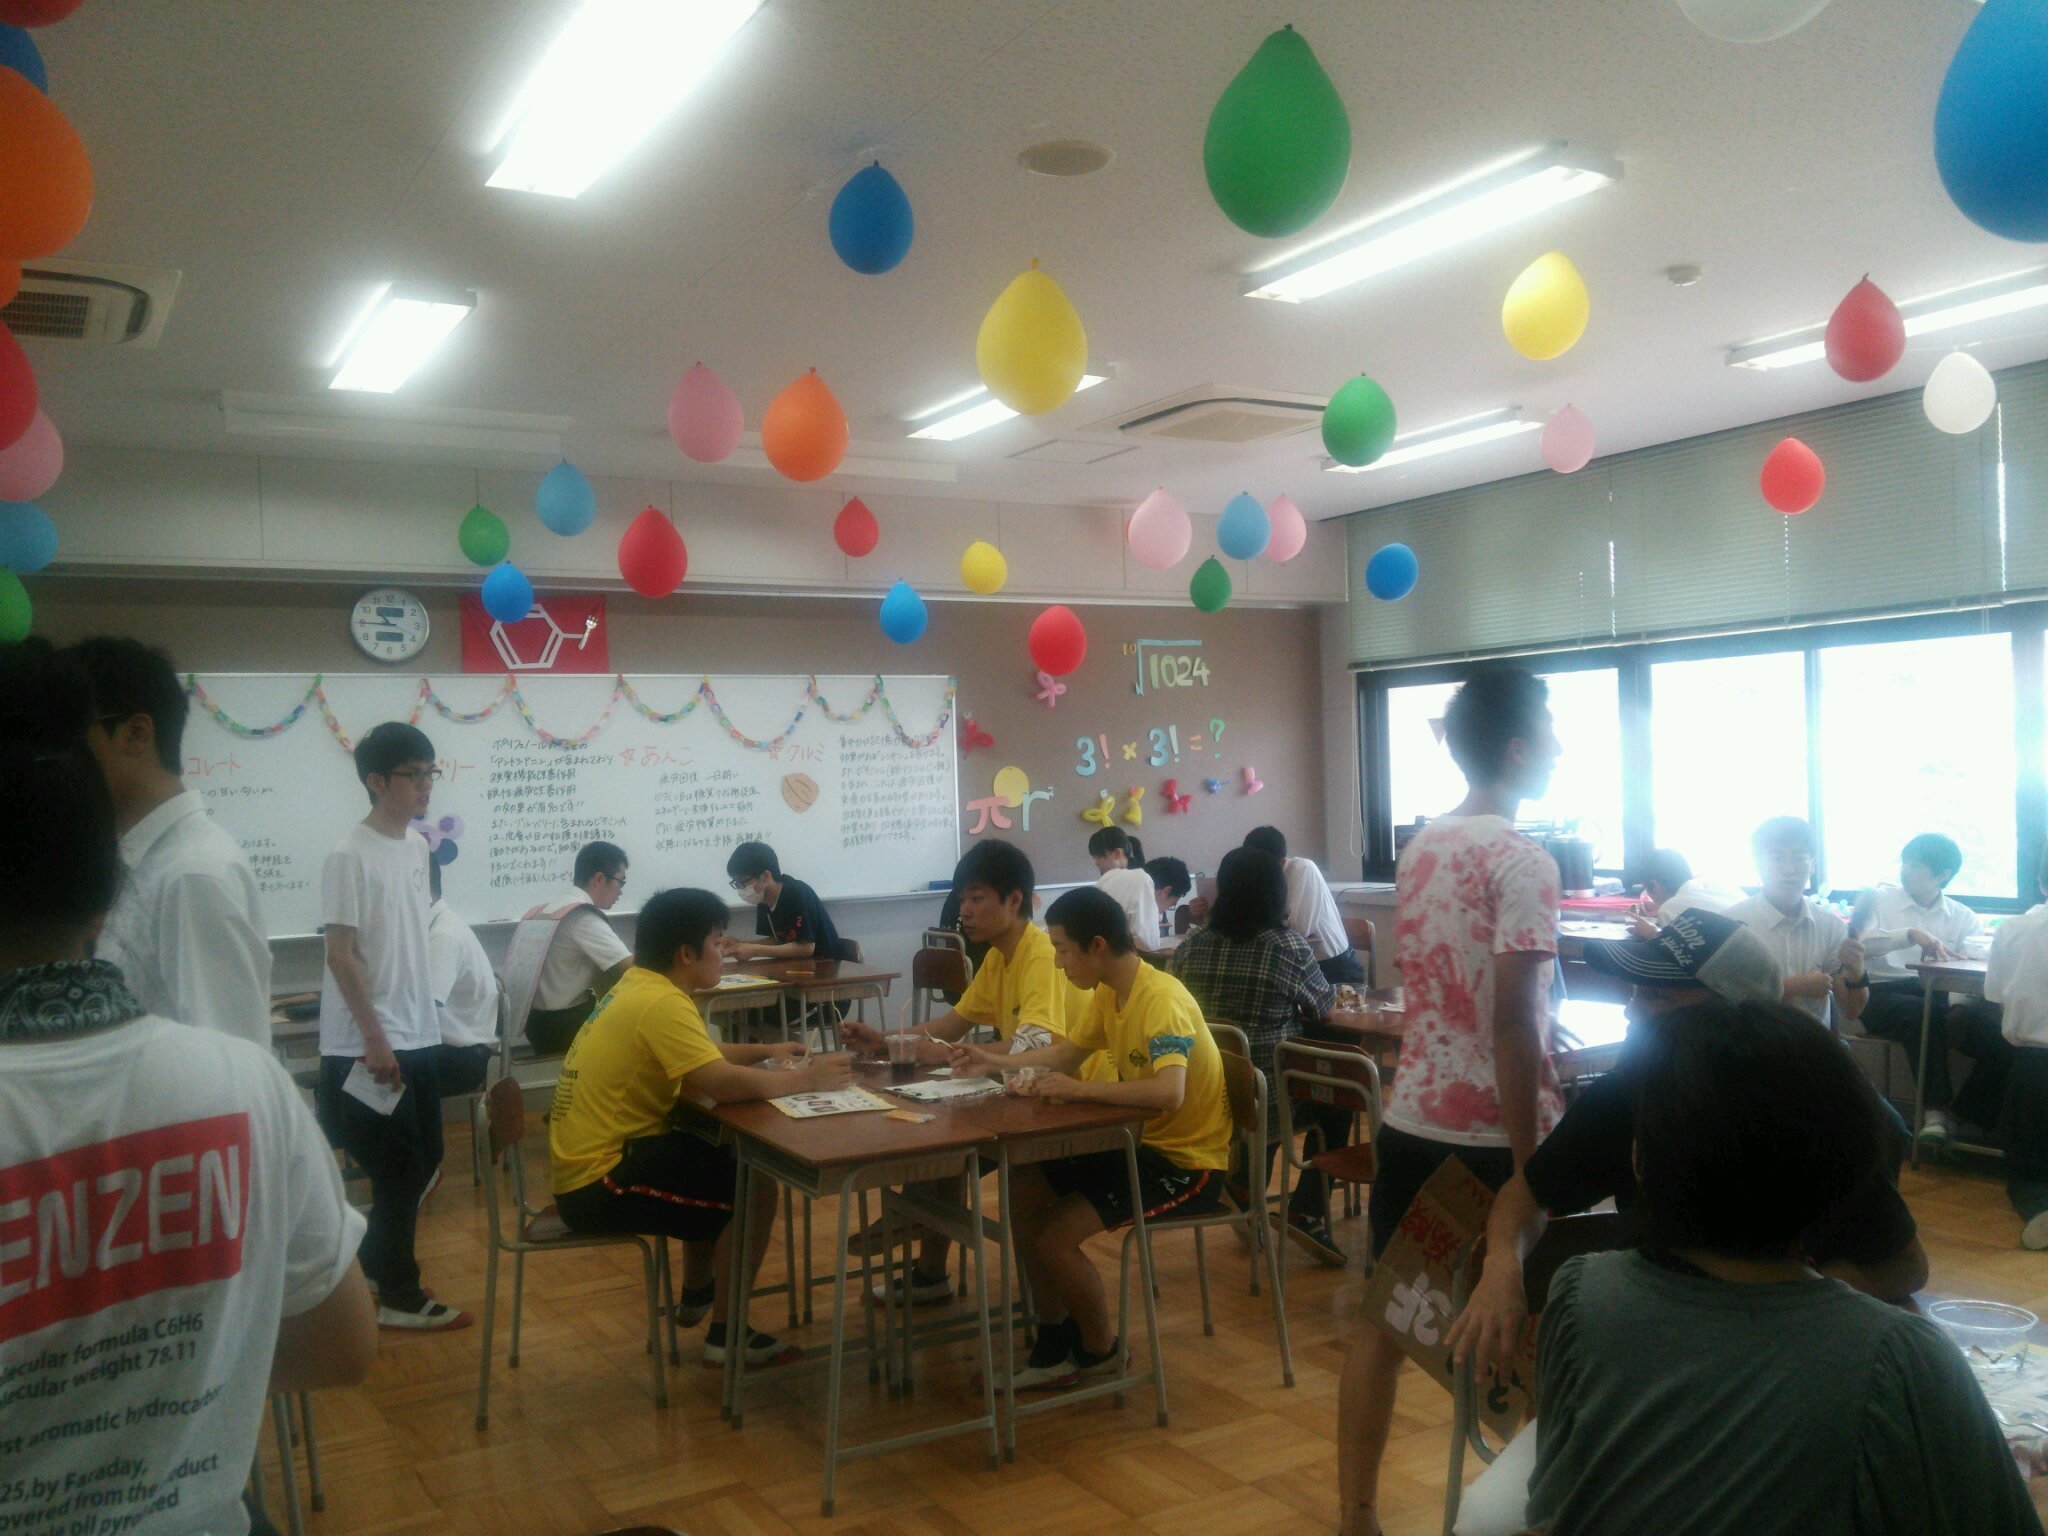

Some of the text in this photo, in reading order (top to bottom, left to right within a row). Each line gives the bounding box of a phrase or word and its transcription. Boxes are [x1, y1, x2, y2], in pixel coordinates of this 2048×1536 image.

[1149, 652, 1211, 690] 1024
[179, 753, 242, 777] コレート
[72, 1323, 149, 1365] formula
[154, 1312, 204, 1340] C6H6
[72, 1351, 142, 1389] weight
[0, 1436, 24, 1454] st
[28, 1410, 120, 1448] aromatic
[75, 1487, 123, 1509] from
